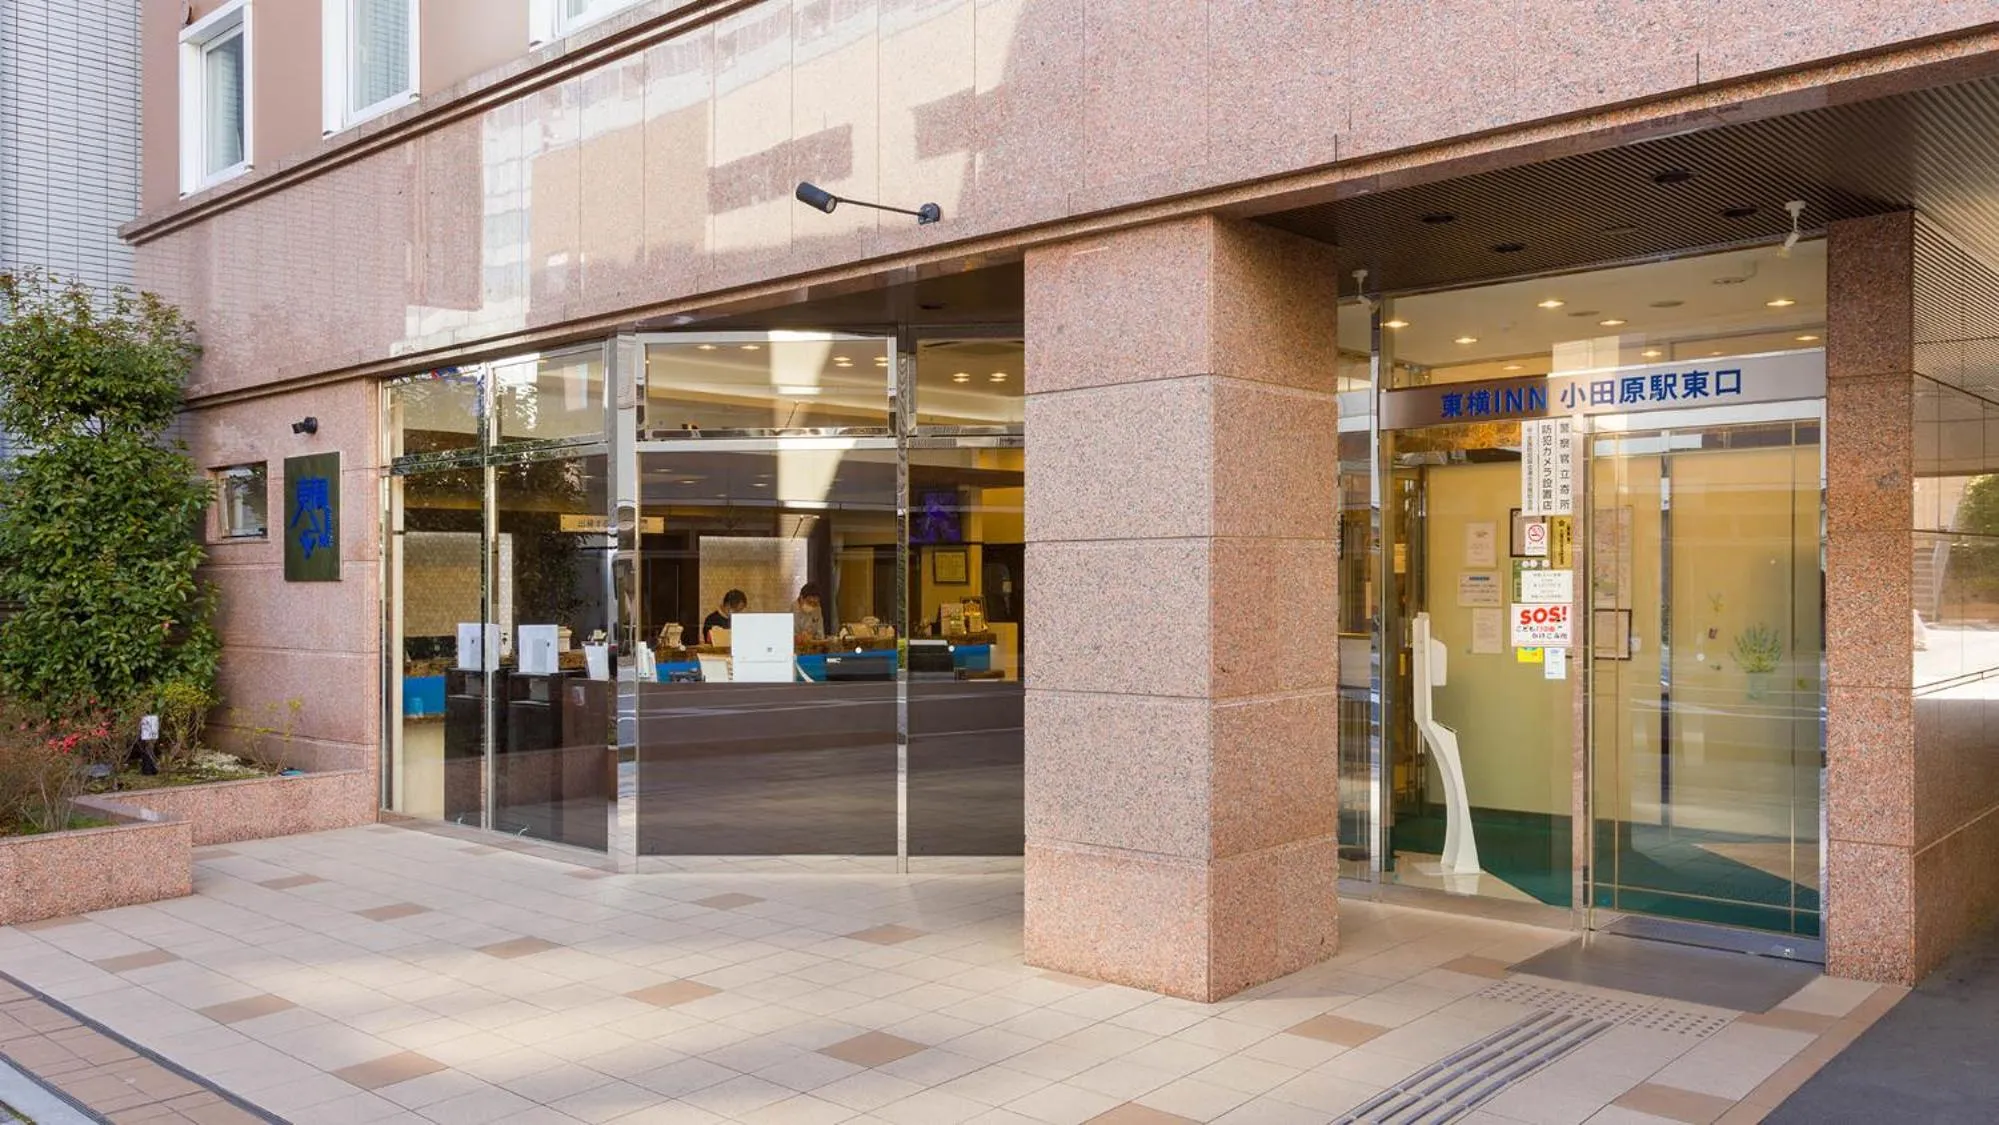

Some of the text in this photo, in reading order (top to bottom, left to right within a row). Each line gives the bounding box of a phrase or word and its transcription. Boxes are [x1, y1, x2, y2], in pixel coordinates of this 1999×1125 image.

[1441, 368, 1742, 418] 東横INN 小田原駅東口
[1541, 424, 1553, 510] 防犯カメラ設置店
[1520, 606, 1567, 625] SOS!
